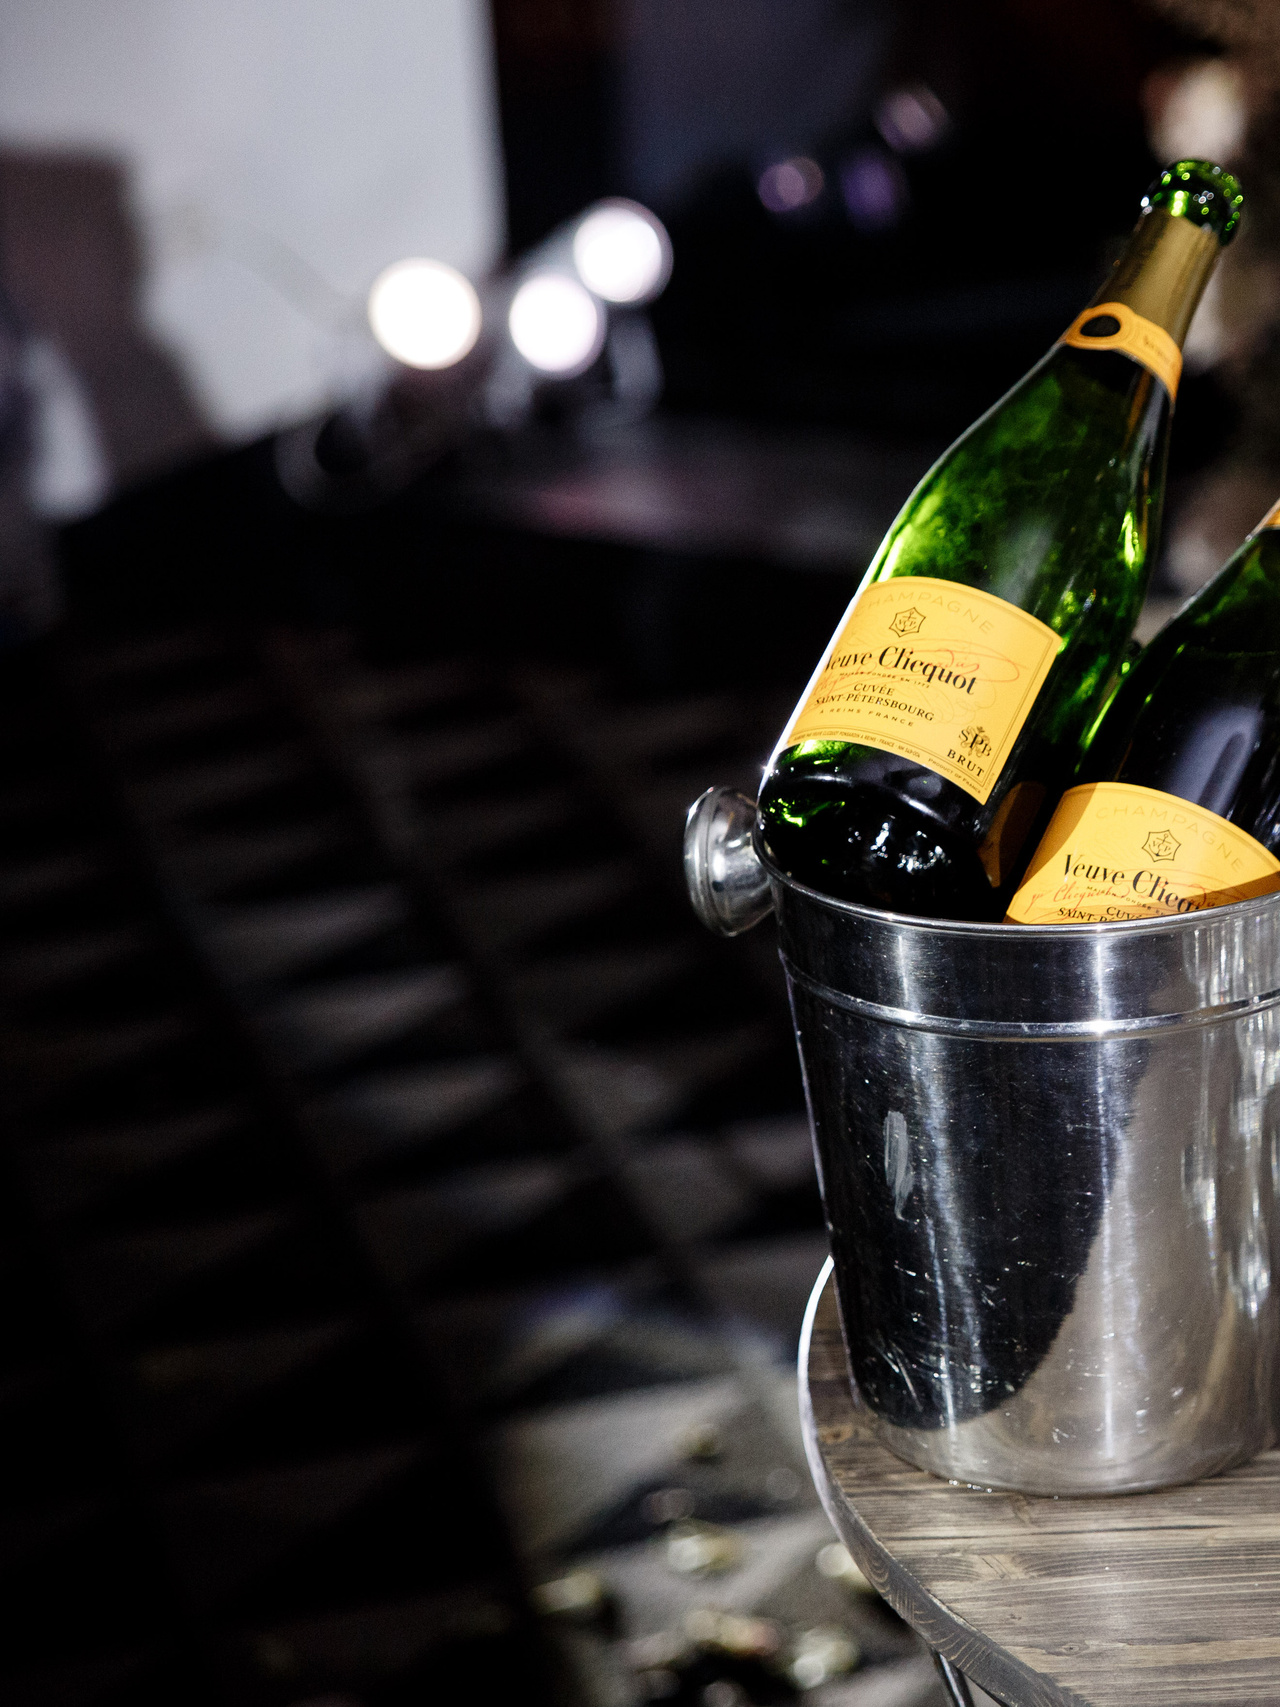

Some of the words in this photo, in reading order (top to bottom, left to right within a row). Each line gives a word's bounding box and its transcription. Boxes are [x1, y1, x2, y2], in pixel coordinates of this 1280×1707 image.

[853, 682, 895, 696] CUVÉE
[878, 645, 977, 696] Clicquot
[868, 710, 914, 727] FRANCE
[947, 748, 985, 778] BRUT
[1095, 805, 1245, 873] CHAMPAGNE
[1064, 853, 1126, 886] Veuve
[1132, 869, 1200, 913] Clicq
